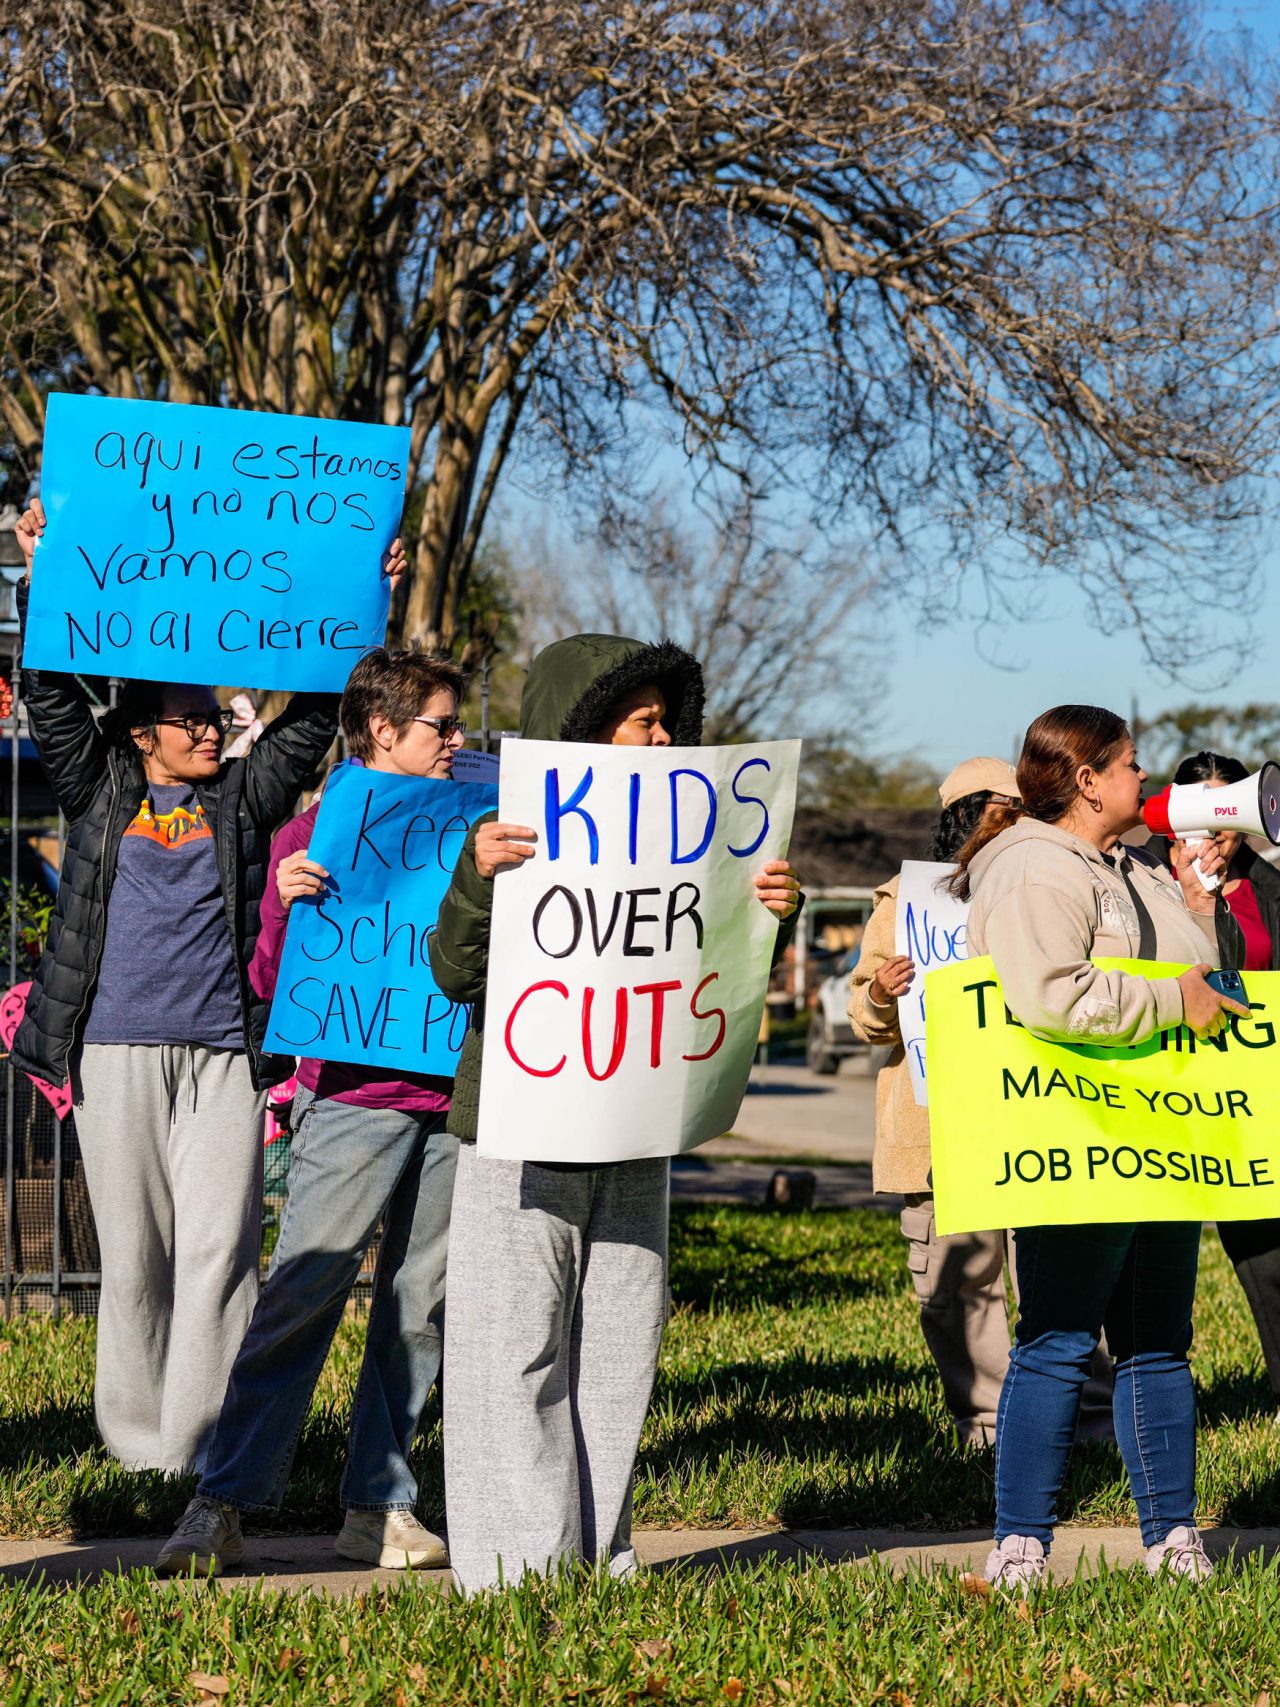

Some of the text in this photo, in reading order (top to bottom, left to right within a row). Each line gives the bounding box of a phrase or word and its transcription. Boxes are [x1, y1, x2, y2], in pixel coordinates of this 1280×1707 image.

[95, 431, 402, 489] aqui estamos
[147, 493, 175, 553] y
[192, 488, 242, 515] no
[544, 757, 770, 865] KIDS
[1214, 806, 1238, 816] PYLE
[533, 882, 703, 958] OVER
[275, 977, 473, 1054] SAVE PO
[505, 972, 726, 1080] CUTS
[1003, 1065, 1253, 1119] MADE YOUR
[994, 1145, 1275, 1188] JOB POSSIBLE
